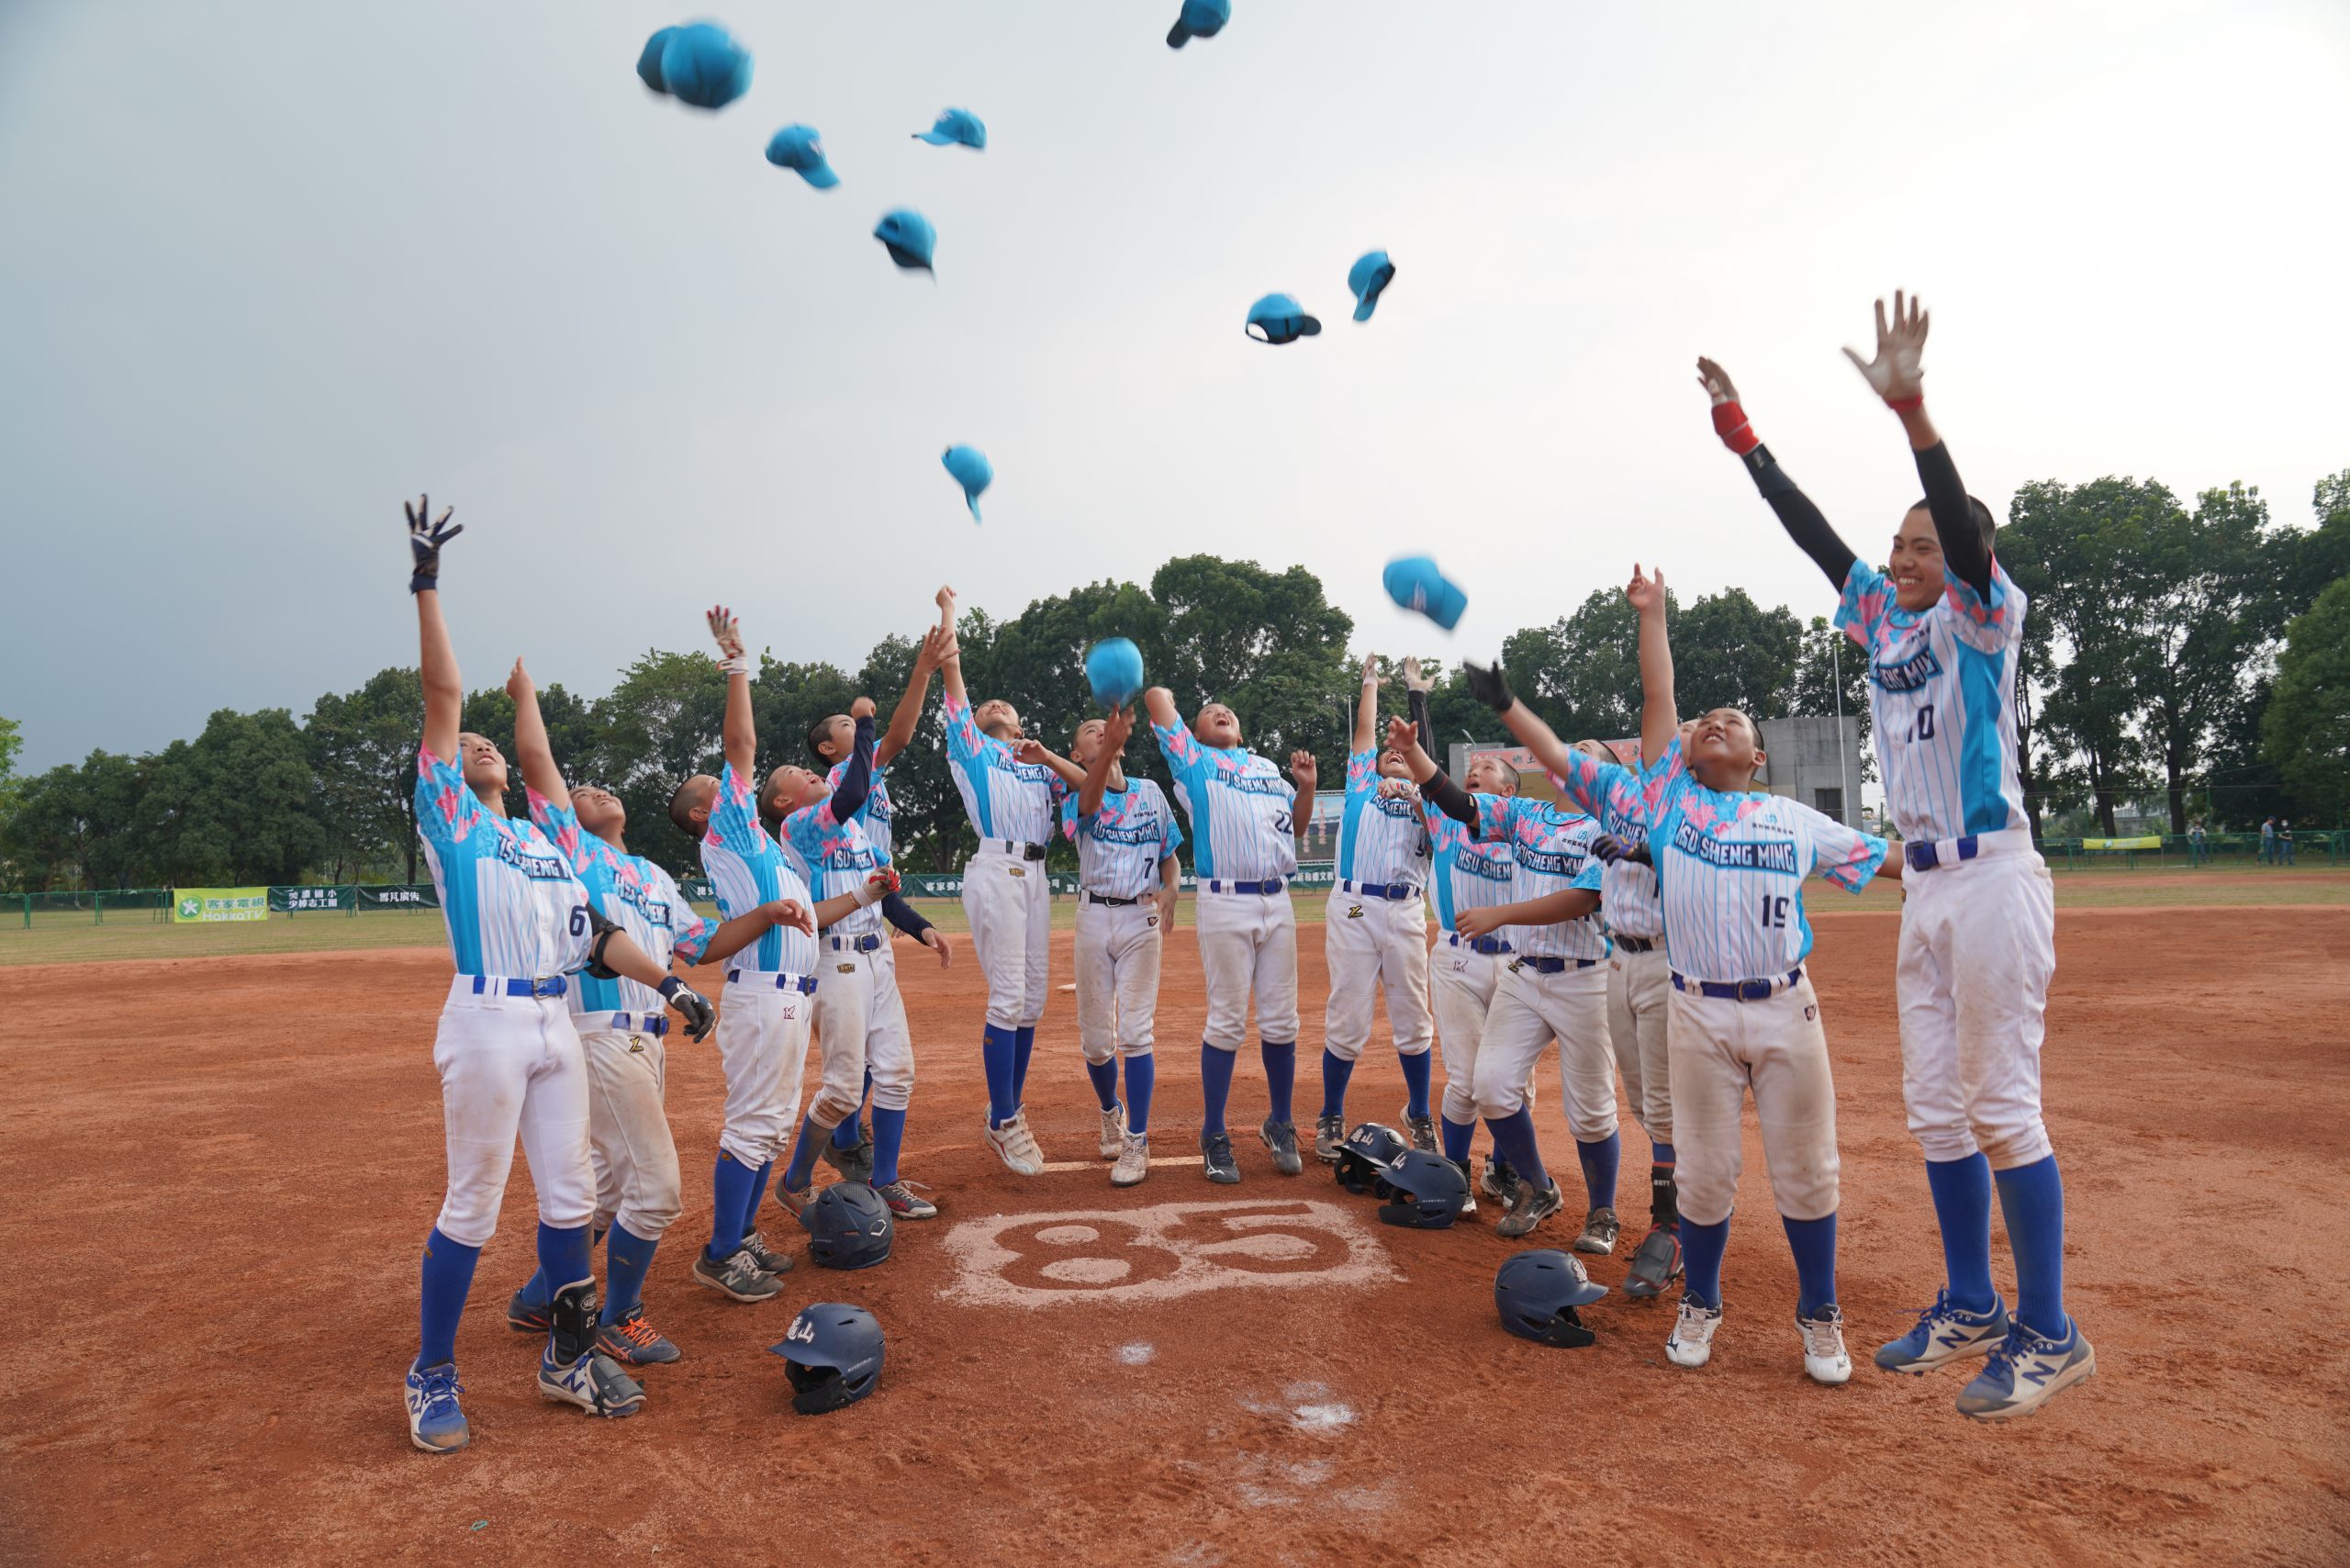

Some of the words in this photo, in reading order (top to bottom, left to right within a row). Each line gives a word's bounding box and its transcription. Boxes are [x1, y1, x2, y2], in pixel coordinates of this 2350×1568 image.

[1274, 809, 1293, 835] 22
[1457, 847, 1480, 873] HSU
[1528, 852, 1561, 872] SHENG
[1699, 835, 1752, 868] SHENG
[1757, 843, 1796, 873] MING
[1144, 857, 1154, 879] 7
[204, 896, 265, 911] 客家電視
[569, 904, 588, 937] 6
[586, 1313, 597, 1329] 25
